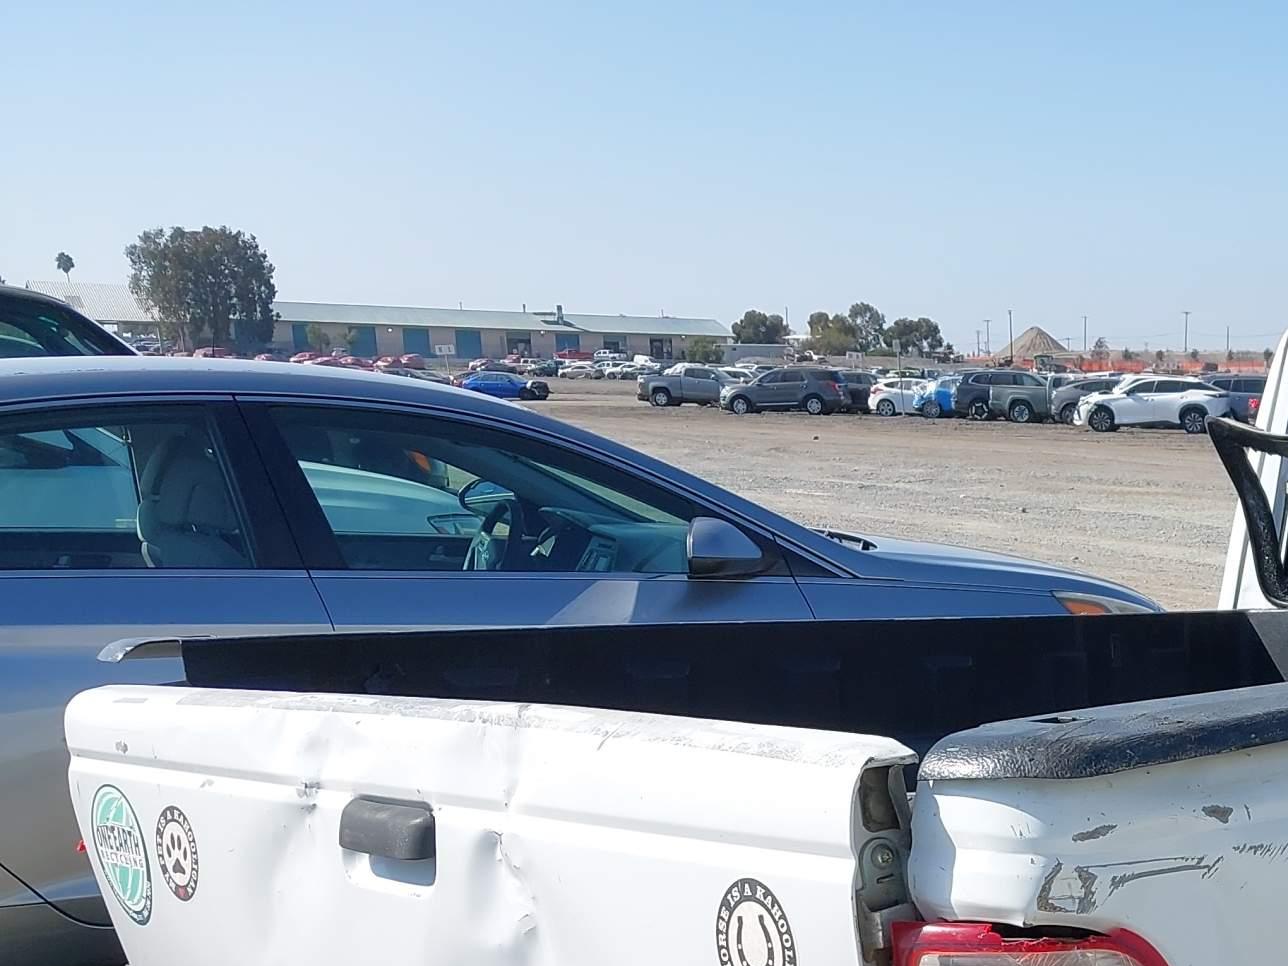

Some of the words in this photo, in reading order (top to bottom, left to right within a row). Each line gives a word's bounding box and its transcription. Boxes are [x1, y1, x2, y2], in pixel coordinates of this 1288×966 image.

[158, 816, 166, 833] IS
[96, 825, 114, 851] ONE
[112, 827, 141, 857] EARTH
[101, 849, 145, 869] RECYCLING
[727, 884, 741, 909] IS
[743, 883, 753, 896] A
